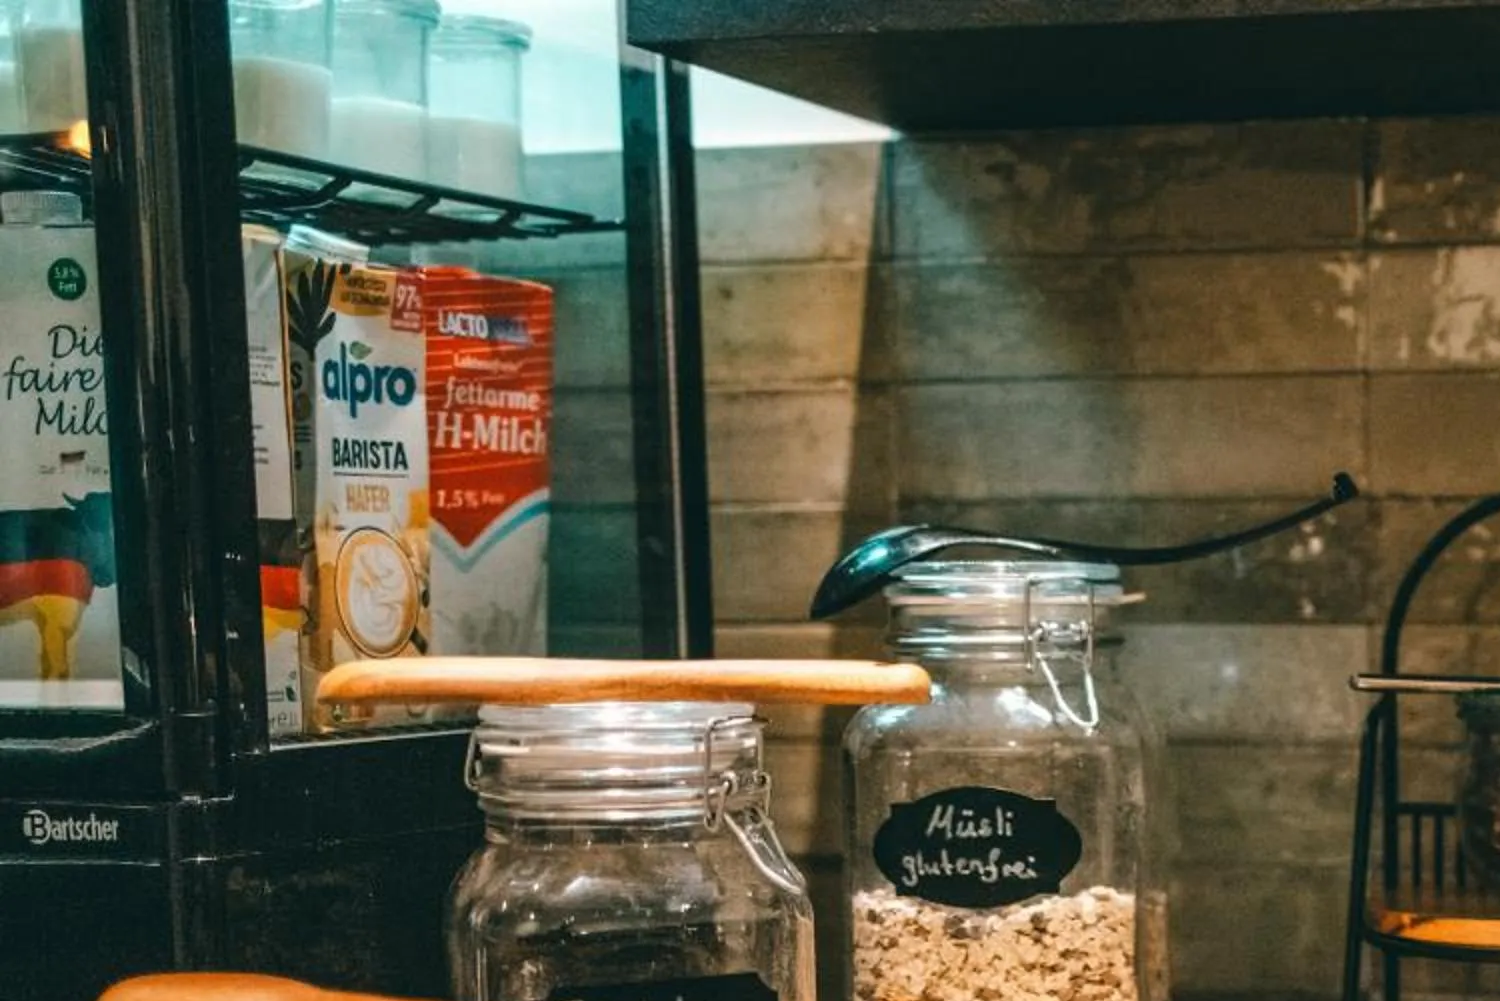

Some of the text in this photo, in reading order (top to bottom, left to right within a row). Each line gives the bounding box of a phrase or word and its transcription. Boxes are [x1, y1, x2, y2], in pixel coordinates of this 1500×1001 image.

[4, 355, 103, 401] faire
[322, 341, 417, 419] alpro
[443, 375, 541, 411] fettarme
[35, 397, 109, 435] Milc
[435, 411, 547, 455] H-Milch
[332, 437, 408, 470] BARISTA
[346, 484, 391, 513] HAFER
[23, 809, 119, 845] Bartscher
[925, 802, 1016, 840] Müsli
[900, 841, 1038, 887] glutenfrei
